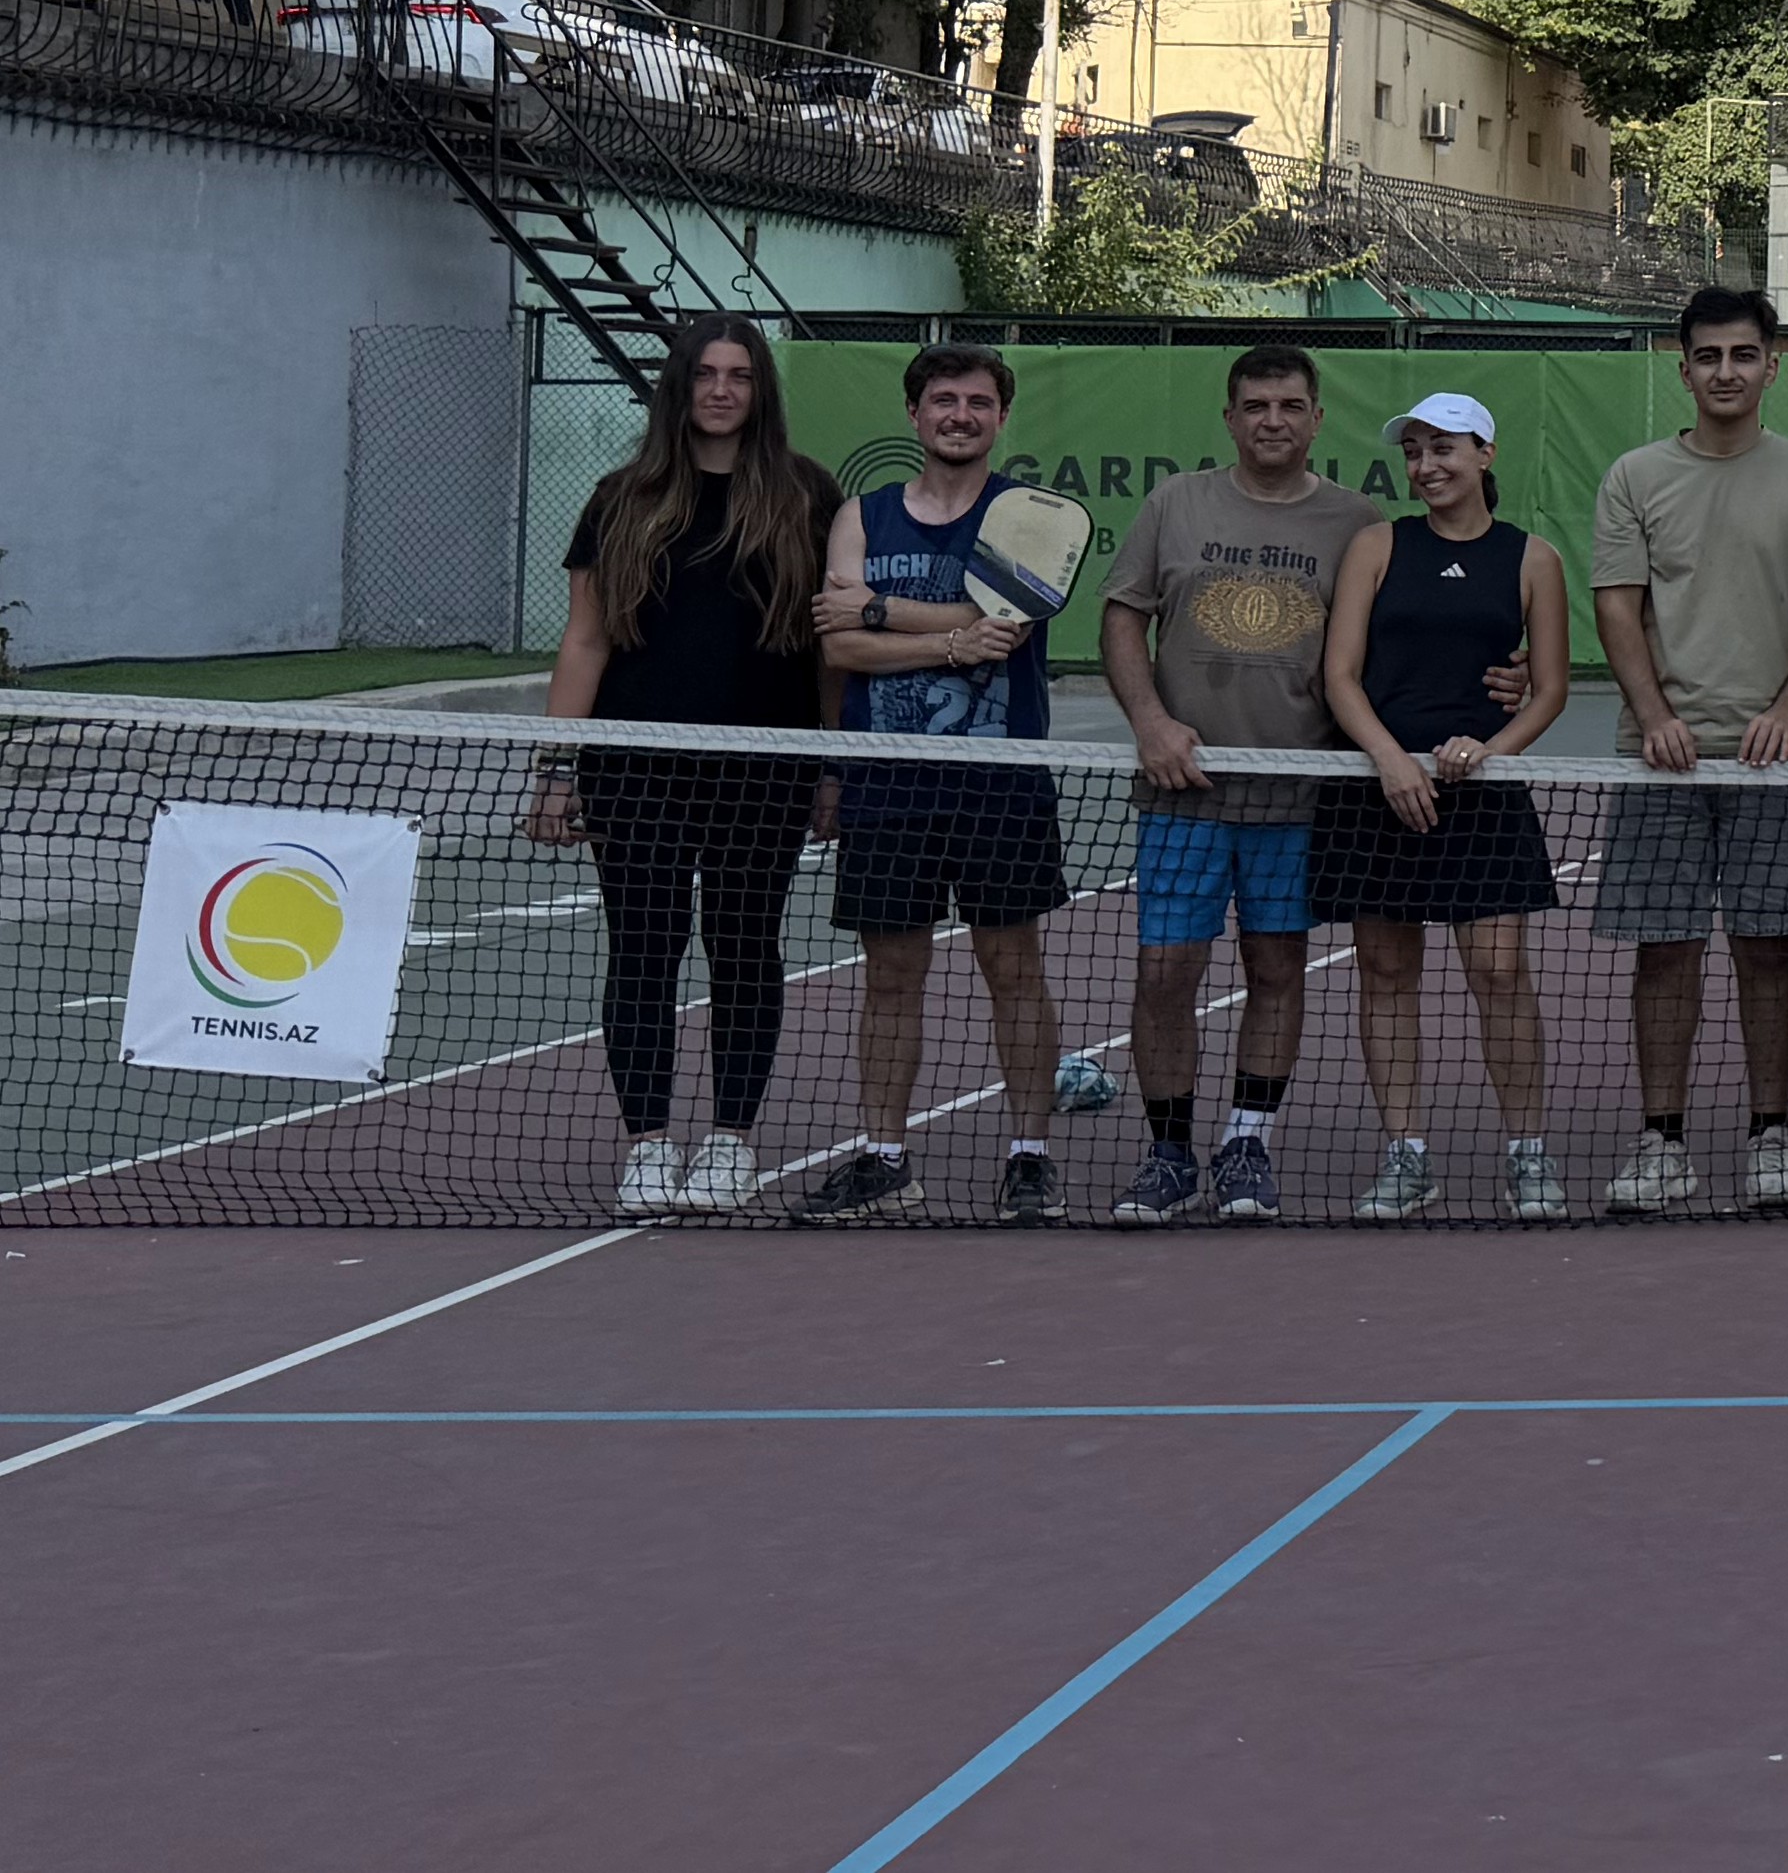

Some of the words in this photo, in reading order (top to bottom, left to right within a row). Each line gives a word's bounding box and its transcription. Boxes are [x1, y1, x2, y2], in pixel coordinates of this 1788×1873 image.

[865, 553, 931, 583] HIGH
[1259, 544, 1318, 577] Ring
[191, 1015, 320, 1044] TENNIS.AZ
